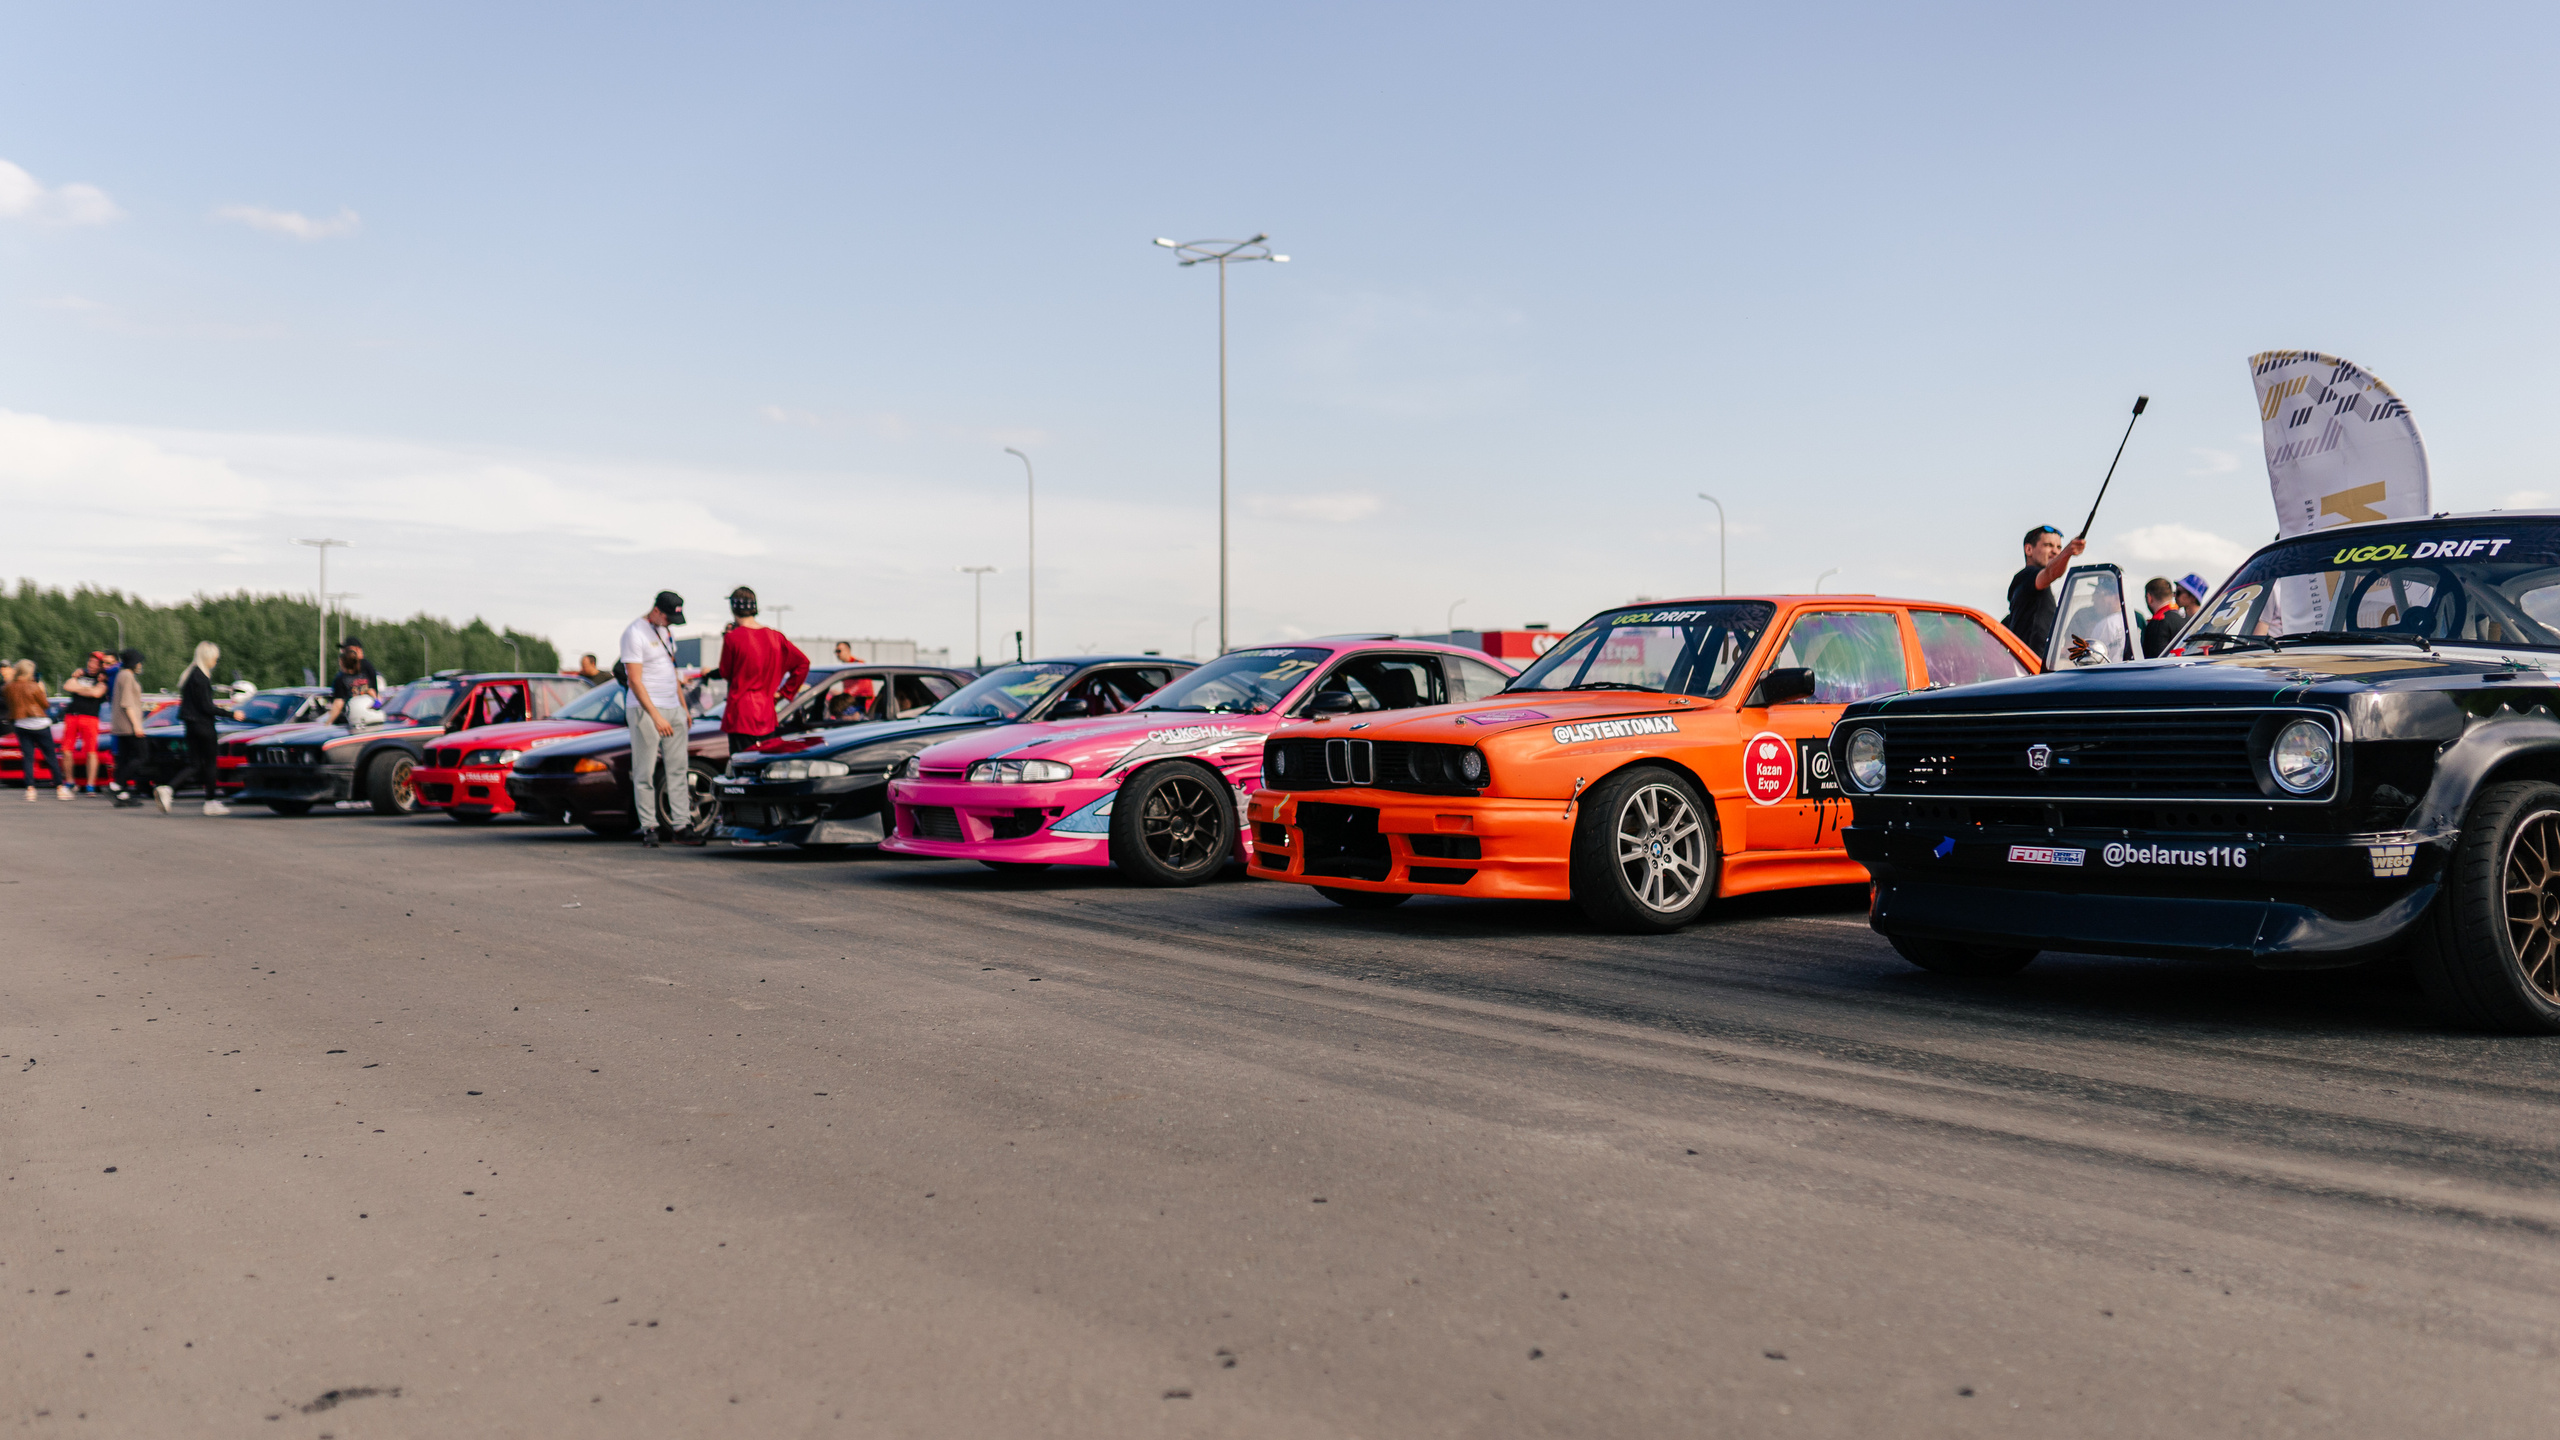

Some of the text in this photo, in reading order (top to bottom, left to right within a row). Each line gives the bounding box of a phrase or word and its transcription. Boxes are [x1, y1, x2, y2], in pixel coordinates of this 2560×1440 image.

[2333, 538, 2511, 564] UGOL DRIFT
[1651, 610, 1707, 623] DRIFT
[1259, 659, 1319, 682] 27
[1553, 716, 1679, 744] @LISTENTOMAX
[1756, 762, 1783, 776] Kazan
[1757, 777, 1780, 793] Expo
[2103, 842, 2248, 869] @belarus116
[2371, 855, 2413, 869] WEGO
